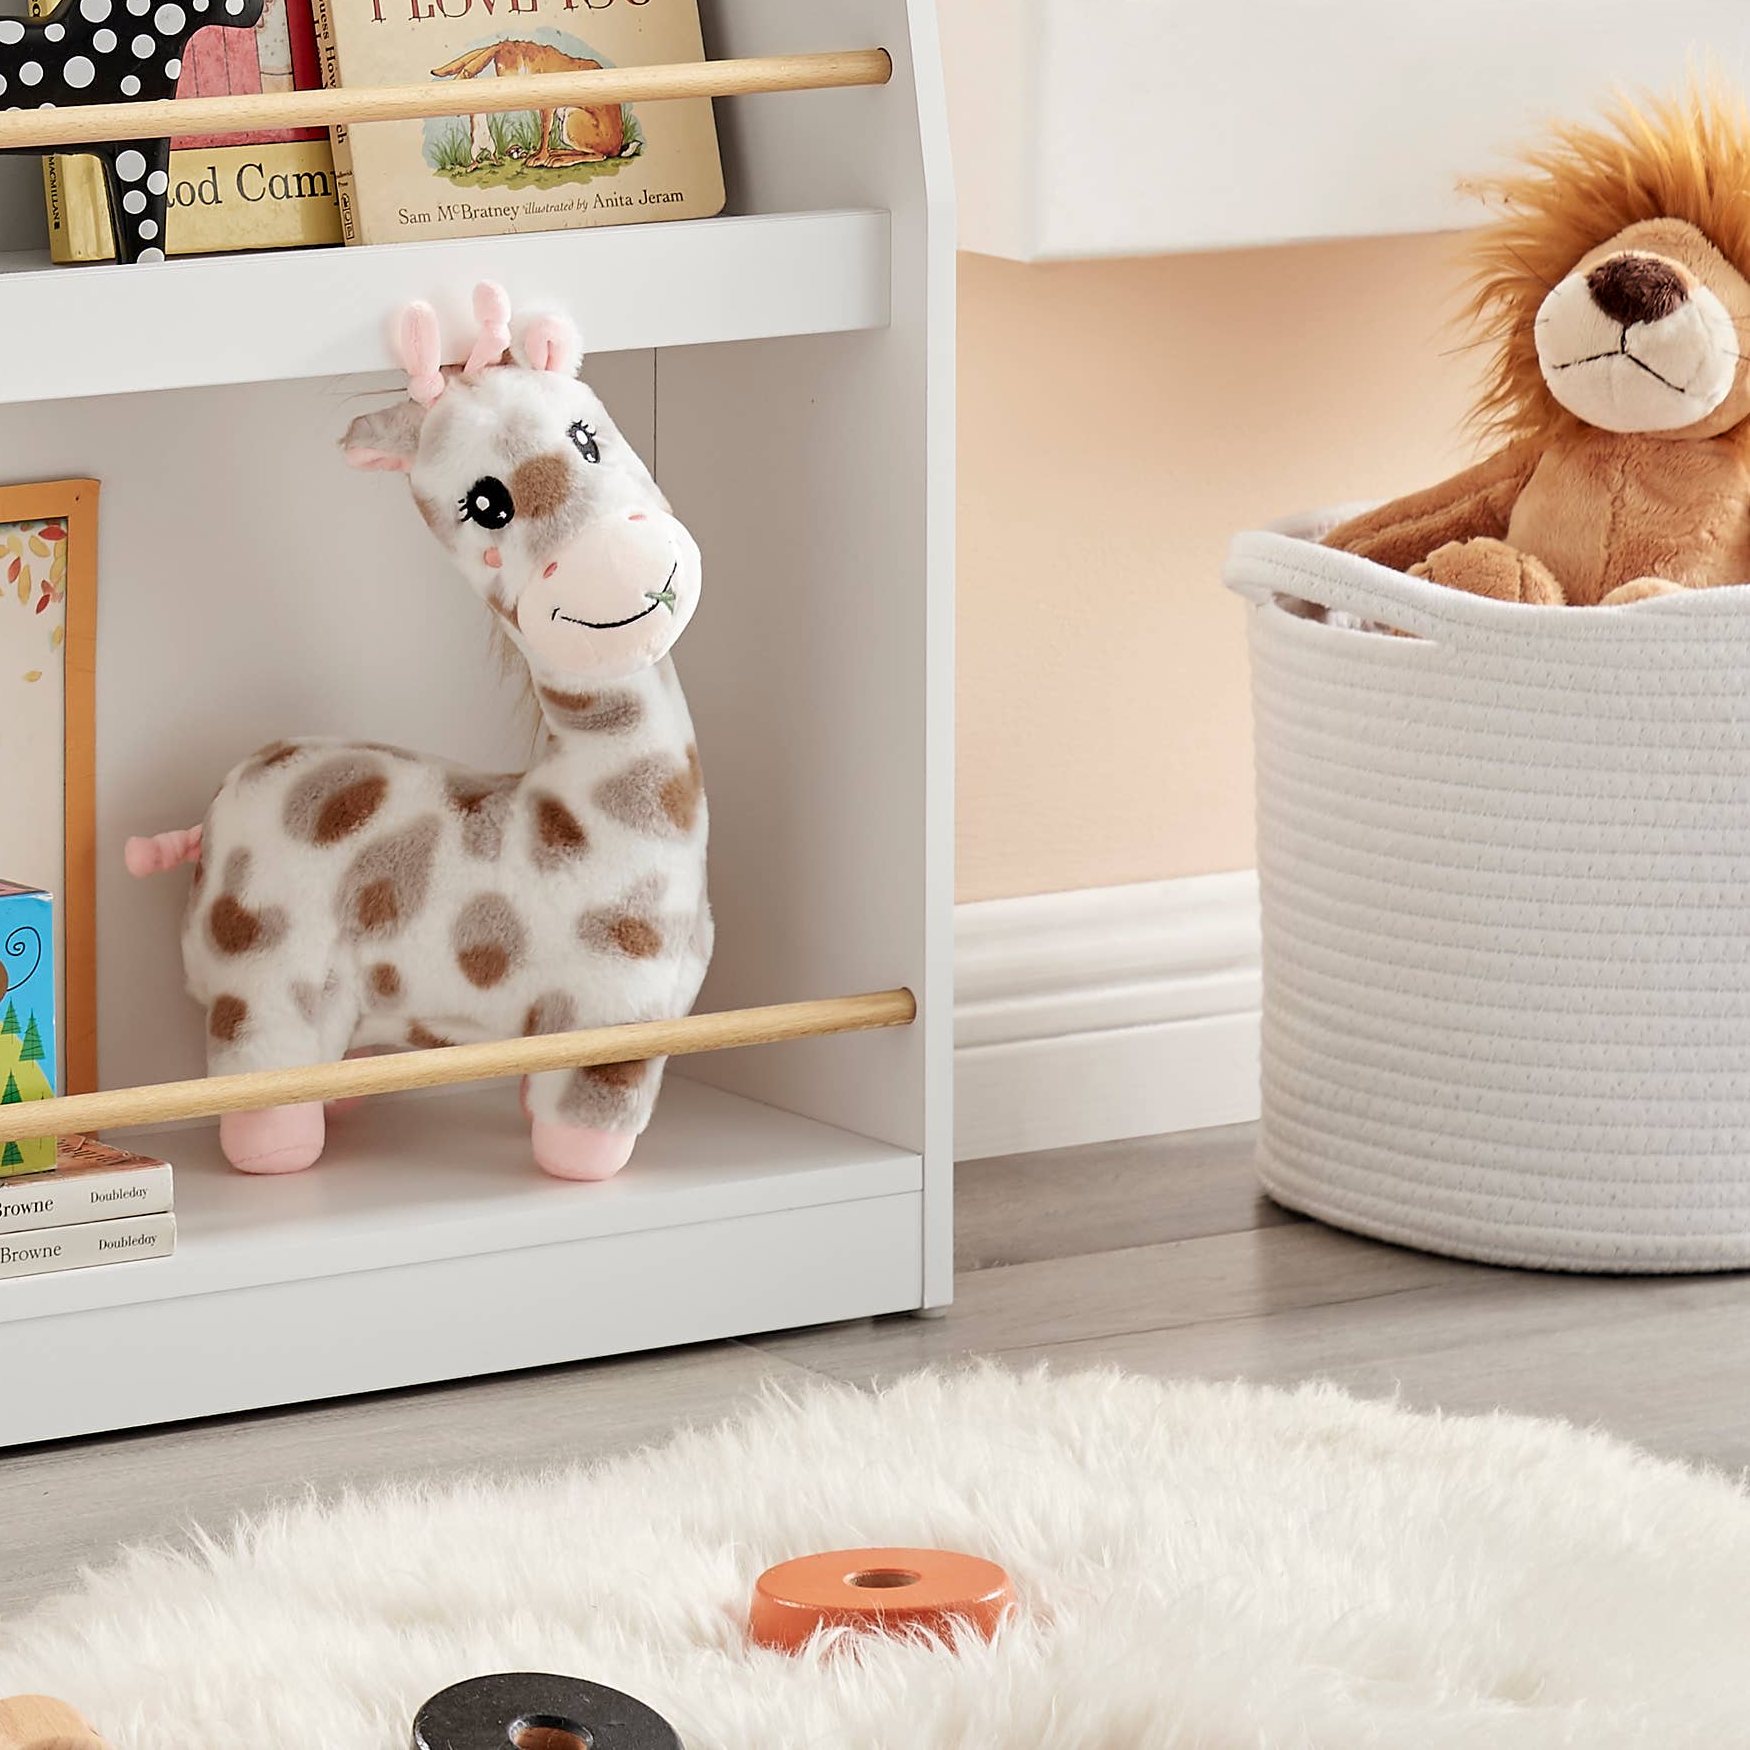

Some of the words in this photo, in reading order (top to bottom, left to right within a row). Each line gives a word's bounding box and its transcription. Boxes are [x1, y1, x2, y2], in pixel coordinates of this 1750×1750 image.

[48, 156, 61, 224] MACMILLAN
[167, 166, 223, 208] od
[236, 162, 339, 207] Cam
[398, 208, 432, 225] Sam
[437, 202, 520, 224] McBratney
[523, 200, 575, 216] illustrated
[576, 198, 588, 212] by
[592, 192, 634, 209] Anita
[638, 189, 684, 206] Jeram
[89, 1185, 149, 1204] Doubleday
[0, 1242, 63, 1265] Browne
[98, 1232, 158, 1252] Doubleday
